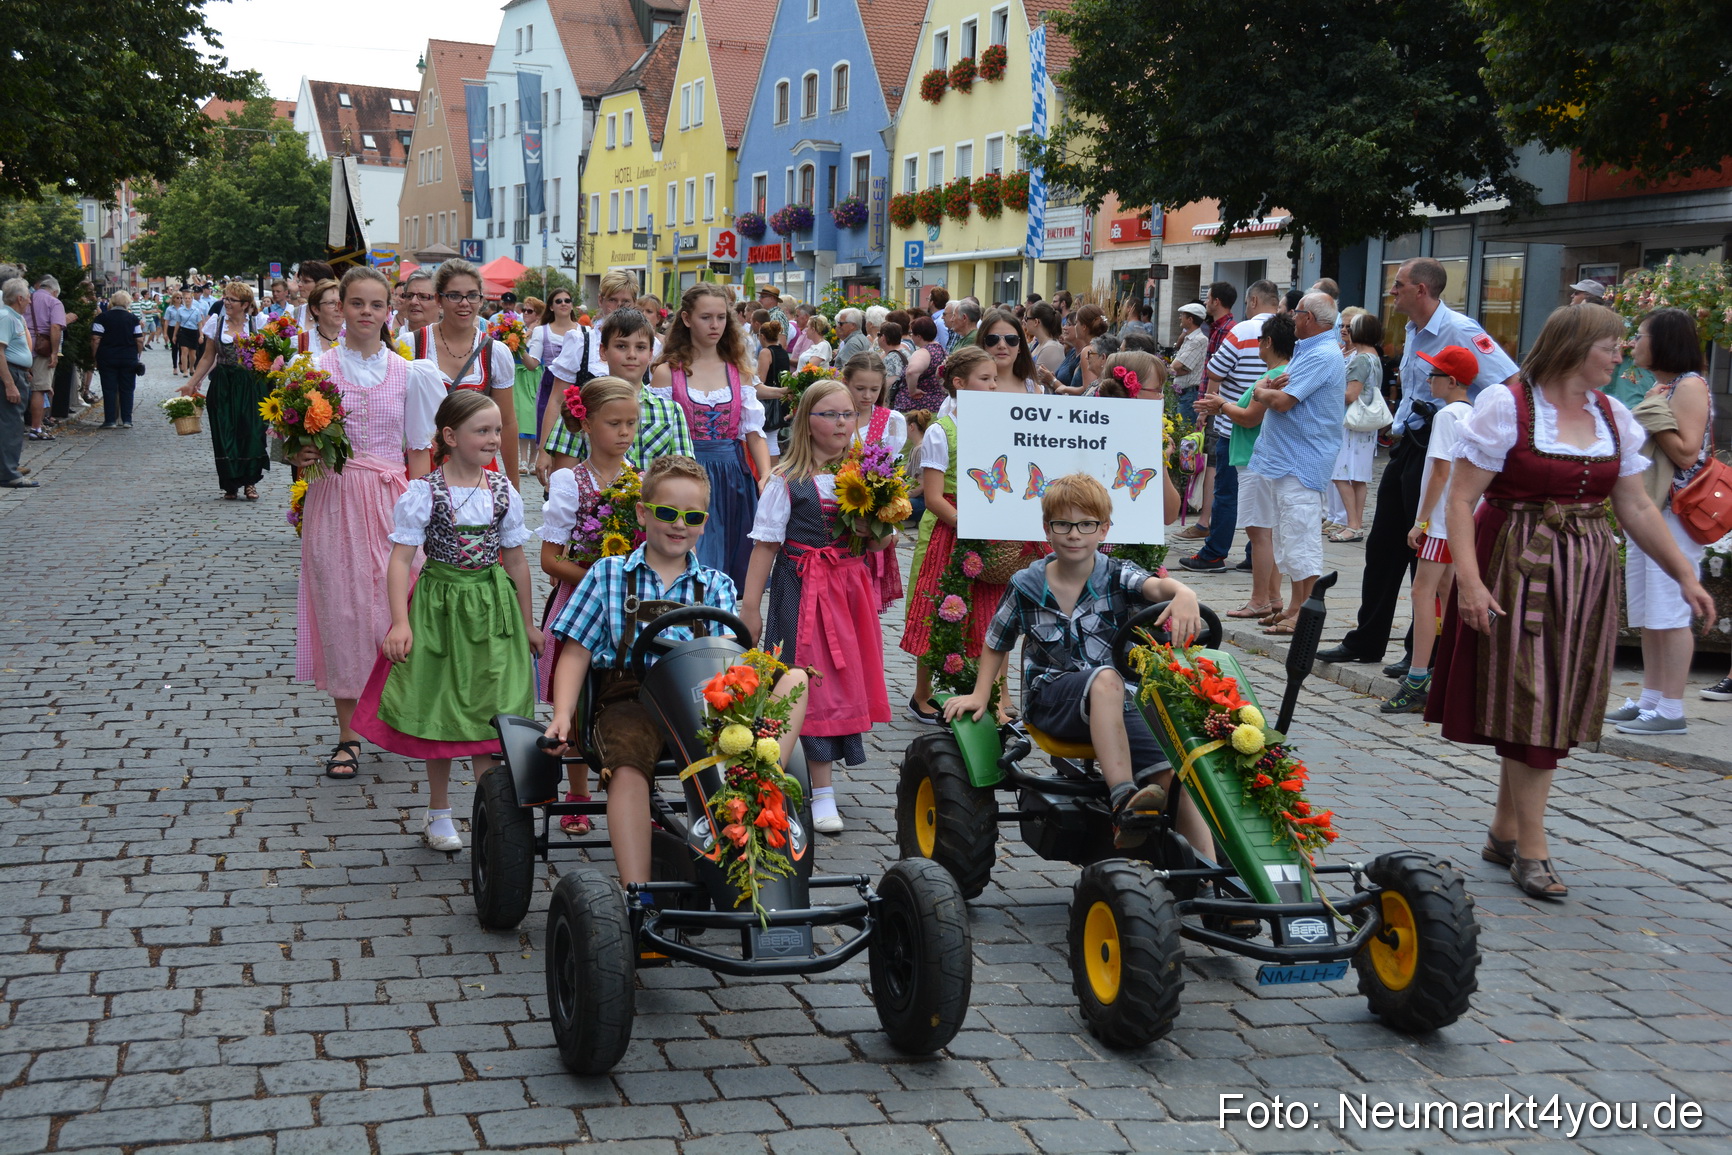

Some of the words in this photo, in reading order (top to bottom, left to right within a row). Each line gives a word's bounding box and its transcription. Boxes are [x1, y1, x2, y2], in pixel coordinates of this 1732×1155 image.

[614, 166, 632, 184] HOTEL
[872, 191, 884, 246] WITTL
[1063, 226, 1076, 238] KINO
[1083, 206, 1092, 256] KINO
[908, 243, 920, 266] P
[1009, 406, 1052, 422] OGV
[1069, 409, 1110, 425] Kids
[1013, 432, 1107, 450] Rittershof
[1290, 925, 1327, 935] BERG
[760, 935, 801, 946] BERG
[1259, 965, 1347, 984] NM-LH-7
